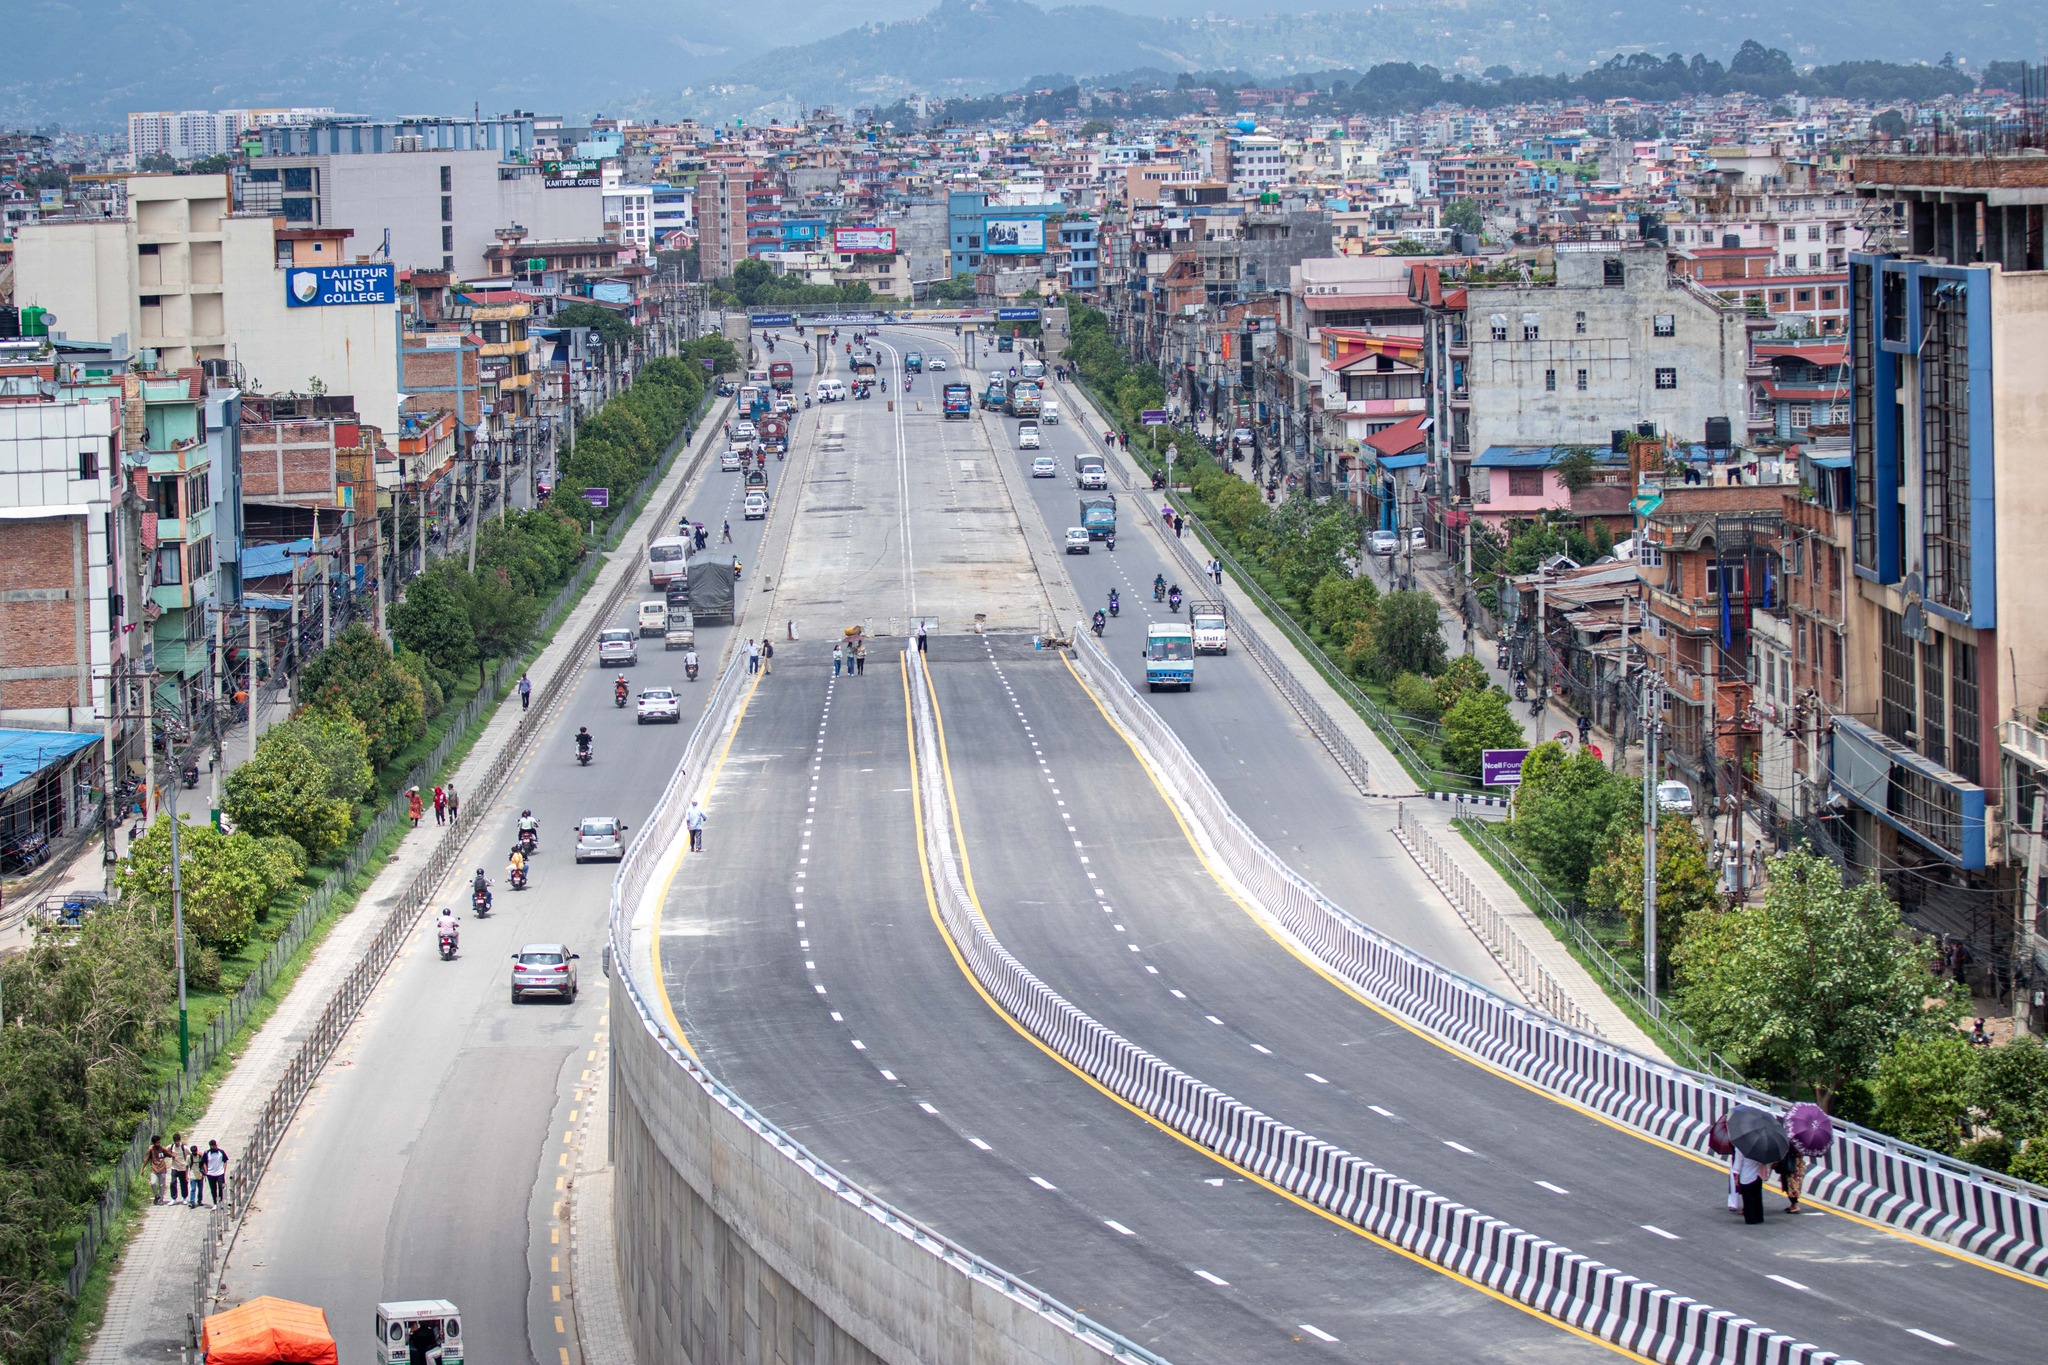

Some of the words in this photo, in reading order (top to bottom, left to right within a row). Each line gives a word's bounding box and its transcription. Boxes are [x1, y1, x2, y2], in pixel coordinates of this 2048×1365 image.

[559, 161, 580, 171] Sanima
[581, 160, 597, 170] Bank
[546, 179, 576, 187] KANTIPUR
[578, 178, 600, 186] COFFEE
[322, 268, 388, 280] LALITPUR
[335, 279, 377, 292] NIST
[323, 292, 385, 304] COLLEGE
